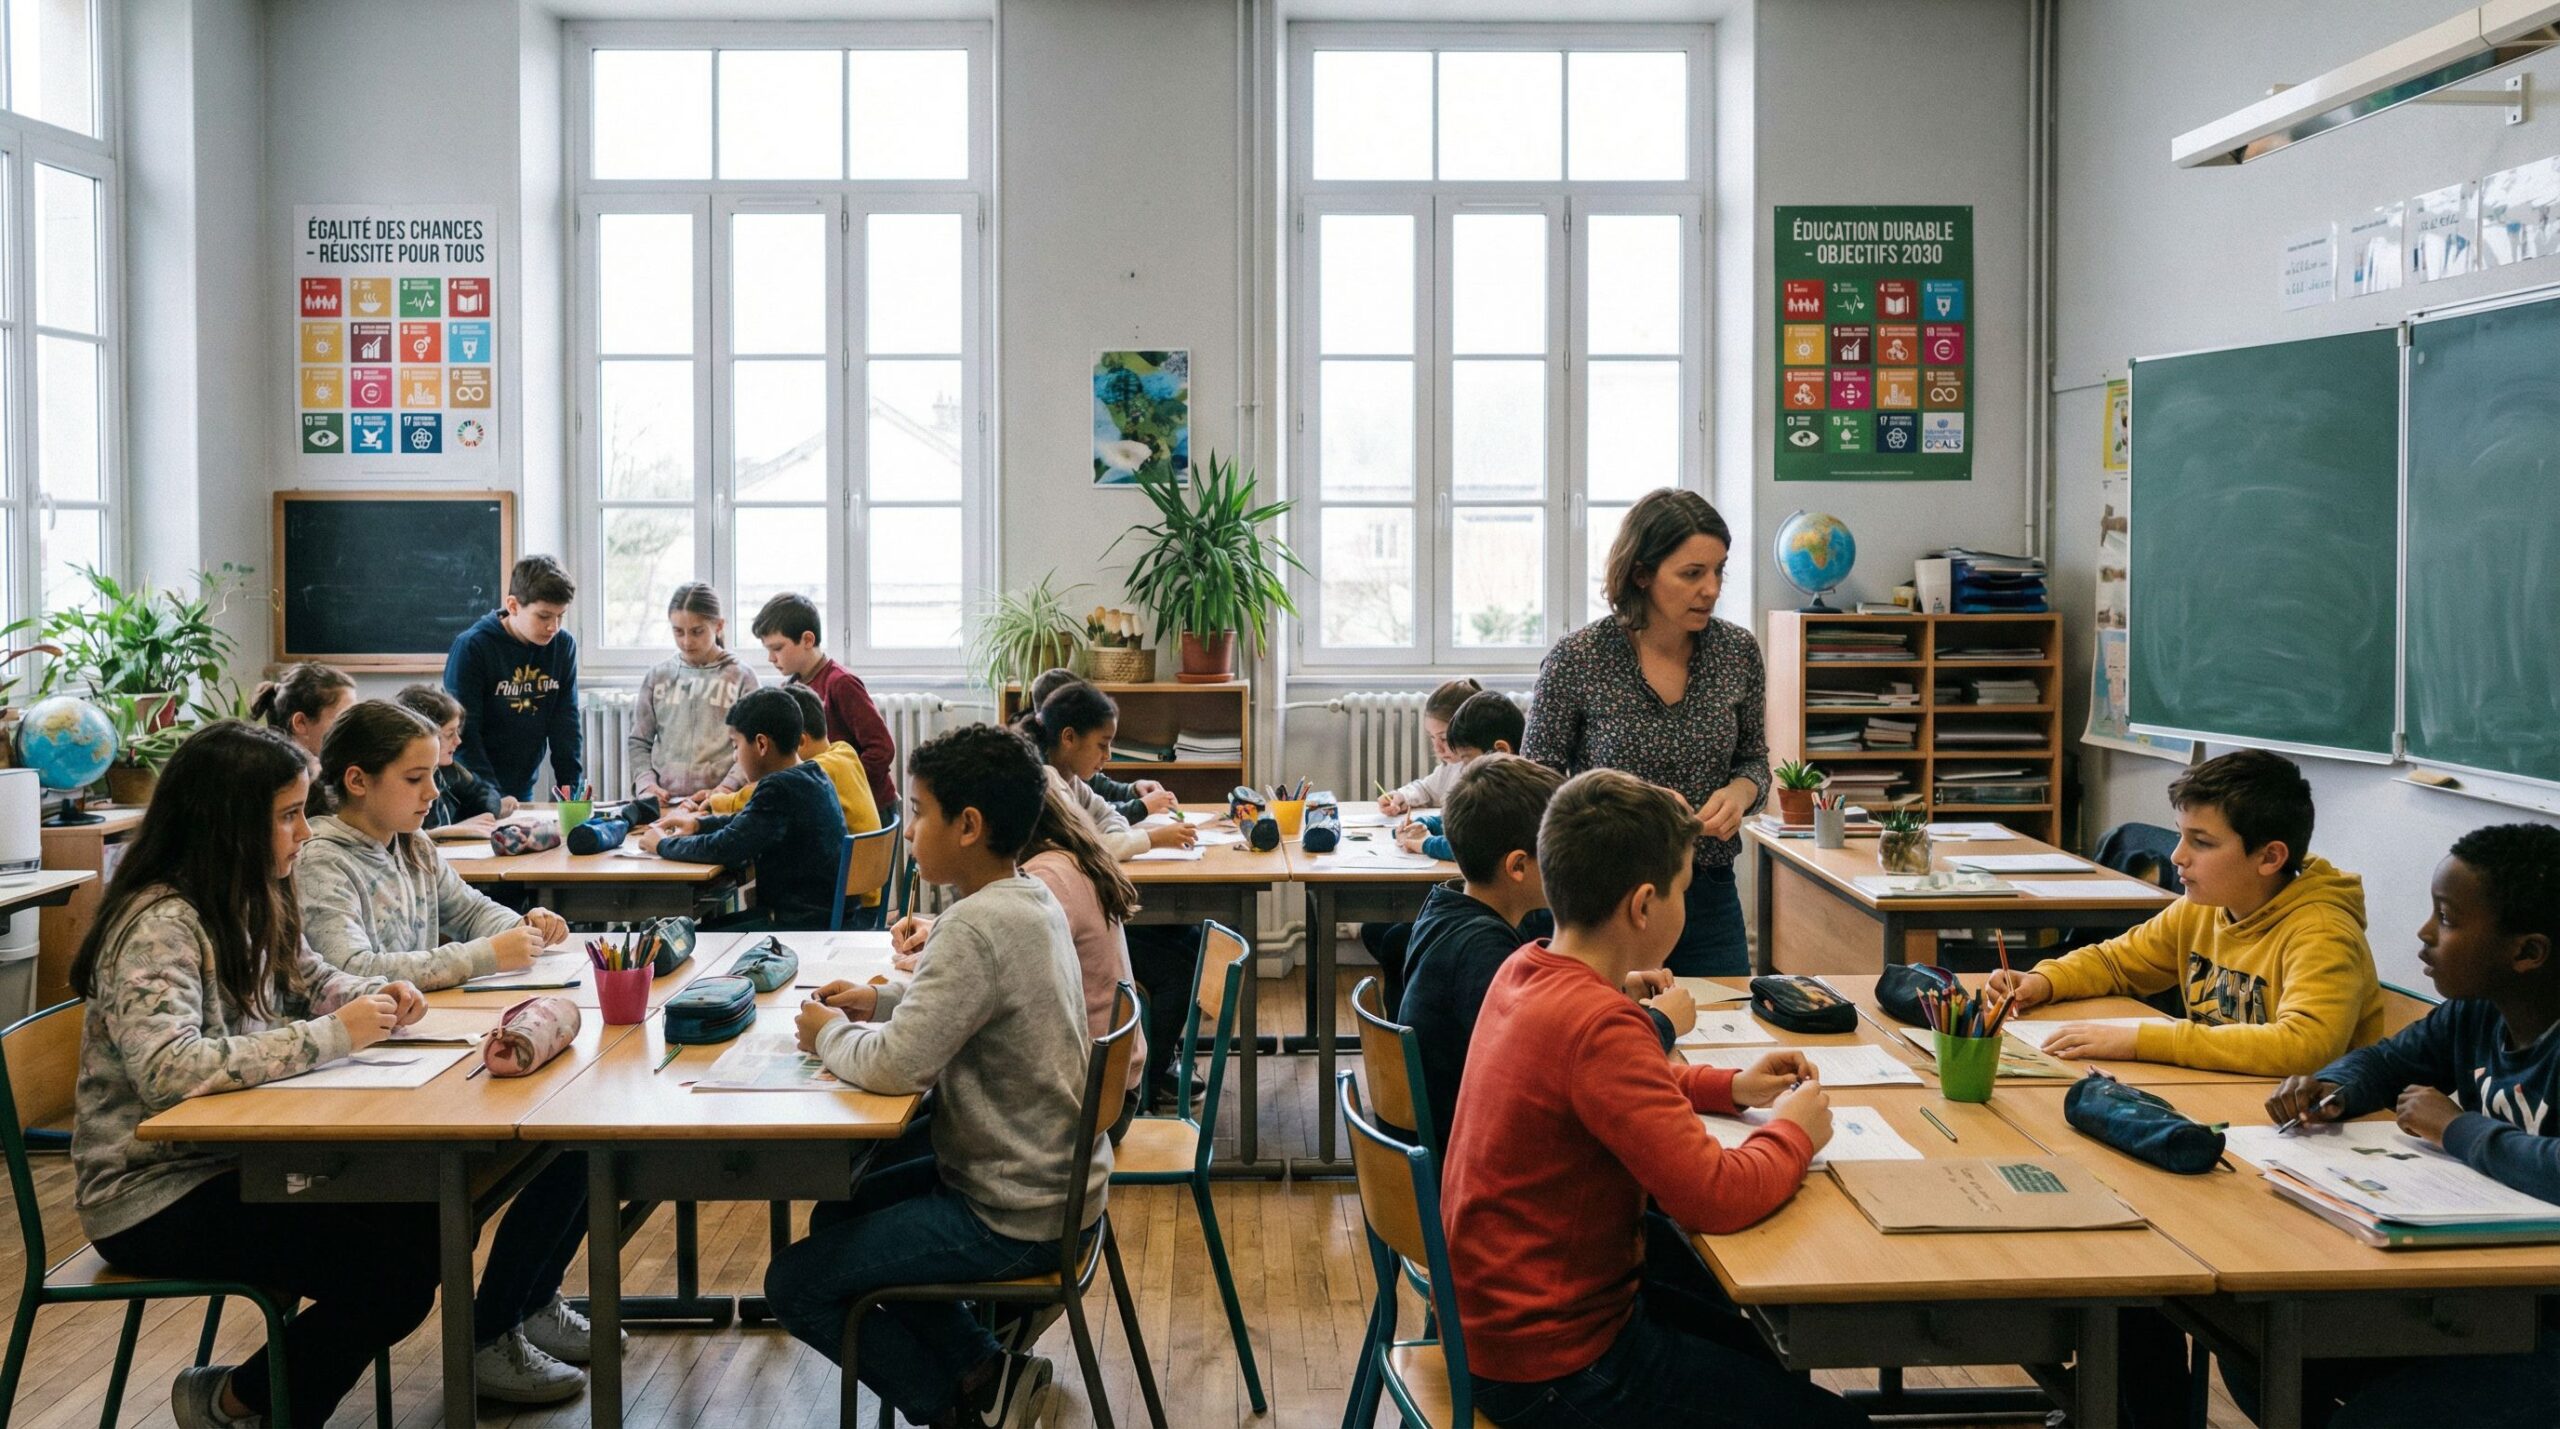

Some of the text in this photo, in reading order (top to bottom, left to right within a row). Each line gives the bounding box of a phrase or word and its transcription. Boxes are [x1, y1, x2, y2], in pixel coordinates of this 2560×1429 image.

[309, 216, 483, 239] ÉGALITÉ DES CHANCES
[1793, 217, 1954, 241] ÉDUCATION DURABLE
[320, 239, 393, 263] RÉUSSITE
[399, 243, 439, 263] POUR
[444, 243, 485, 263] TOUS
[1817, 244, 1898, 264] OBJECTIFS
[1902, 244, 1942, 264] 2030
[352, 280, 359, 290] 2
[451, 280, 457, 290] 4
[1832, 283, 1838, 293] 3
[1880, 283, 1885, 292] 4
